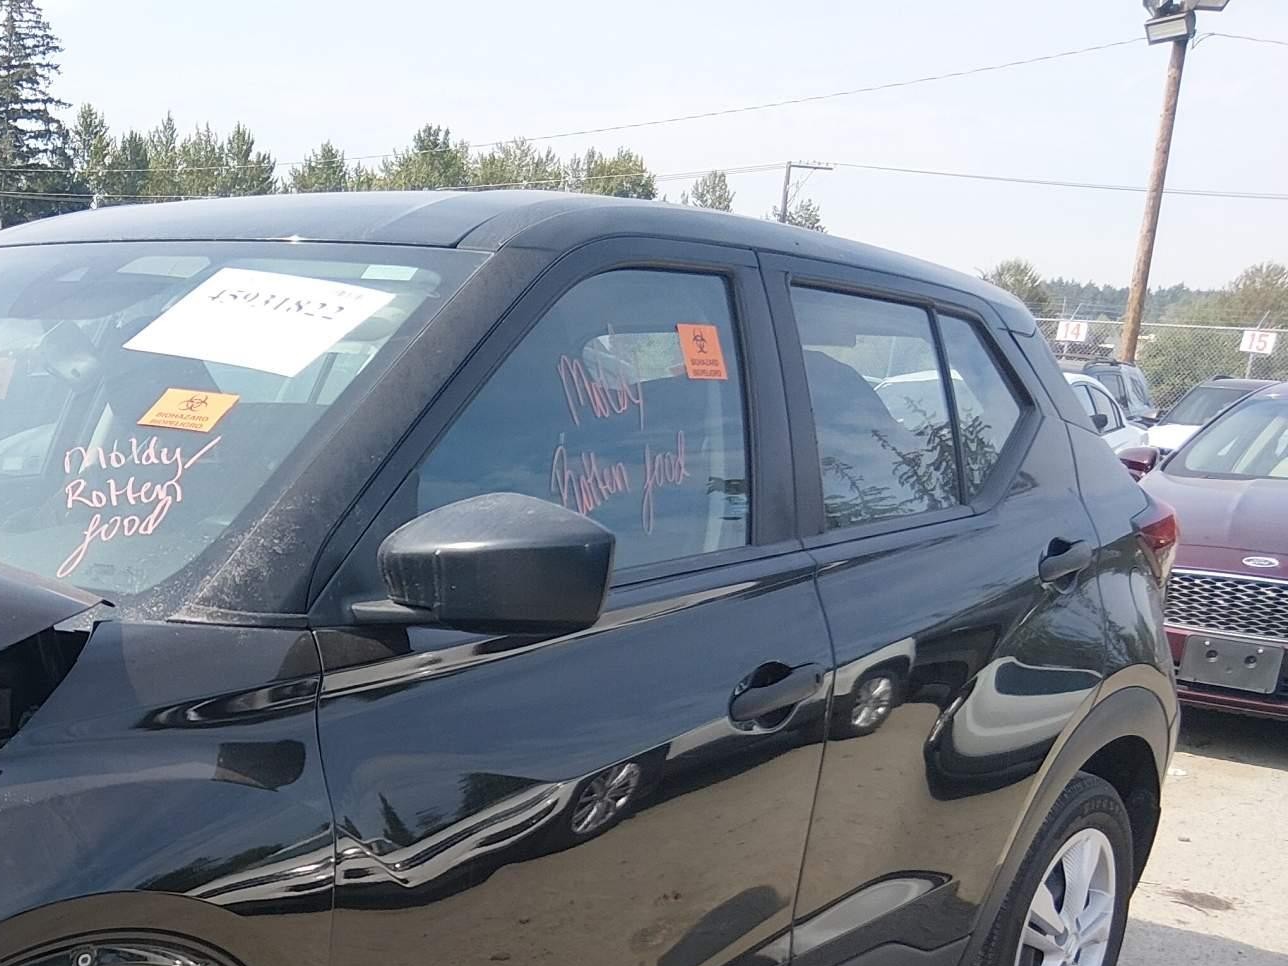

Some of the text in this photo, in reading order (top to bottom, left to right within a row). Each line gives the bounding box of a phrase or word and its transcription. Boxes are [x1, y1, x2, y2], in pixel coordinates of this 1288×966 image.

[1063, 322, 1081, 340] 14
[1248, 332, 1270, 352] 15
[155, 411, 210, 422] BIOHAZARD
